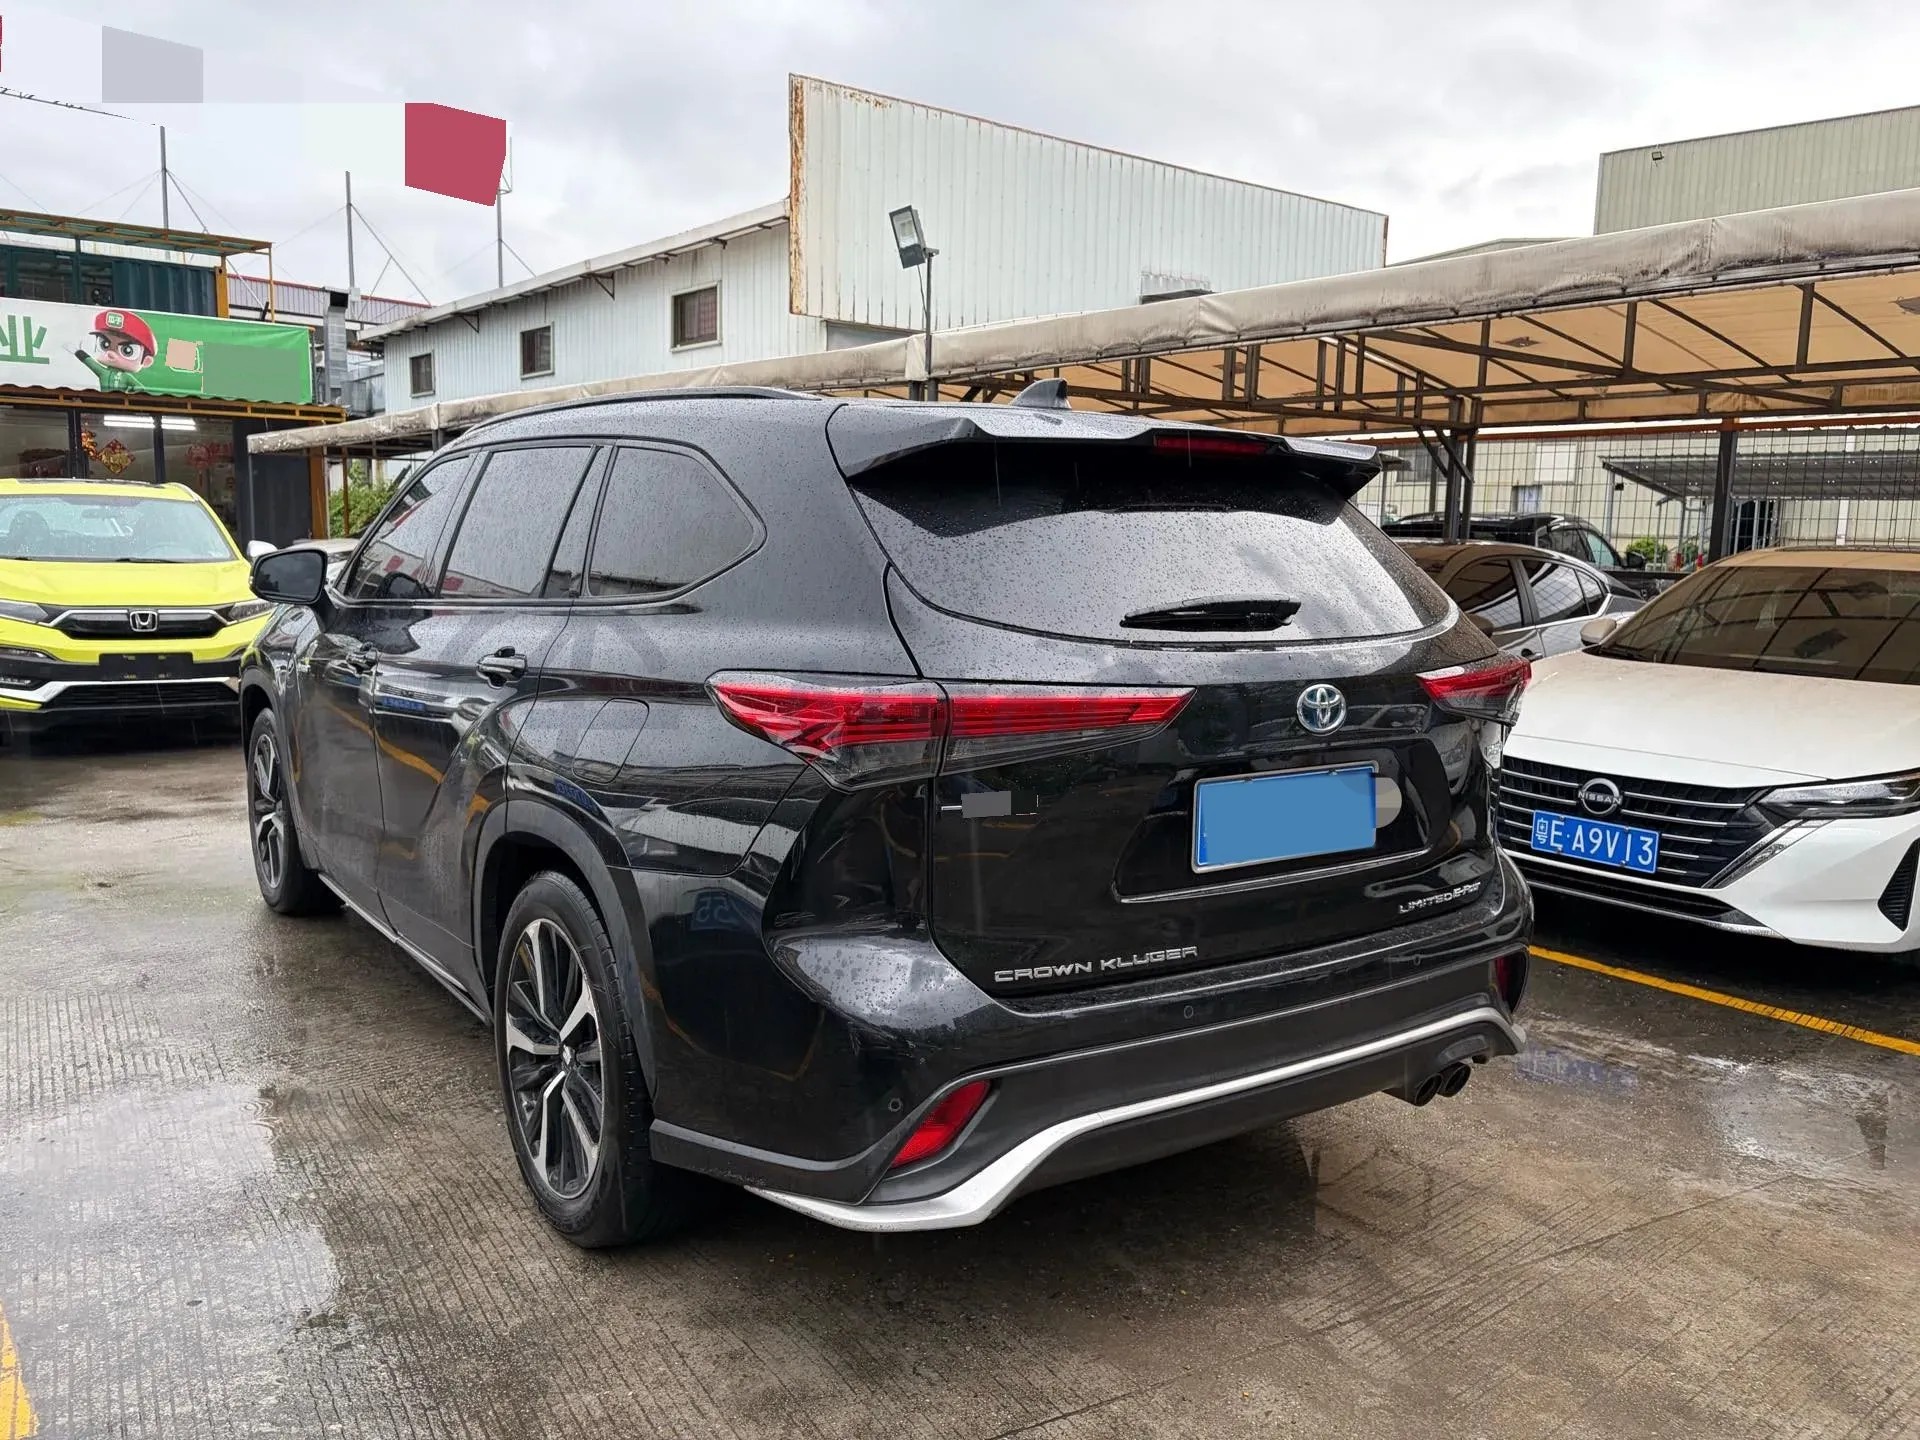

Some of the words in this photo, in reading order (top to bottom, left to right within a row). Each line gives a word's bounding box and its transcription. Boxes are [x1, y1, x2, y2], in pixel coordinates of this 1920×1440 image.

[0, 314, 50, 365] 业
[1577, 790, 1624, 805] NISSAN
[1399, 892, 1453, 914] LIMITED
[994, 961, 1093, 983] CROWN
[1100, 946, 1198, 971] KLUGER
